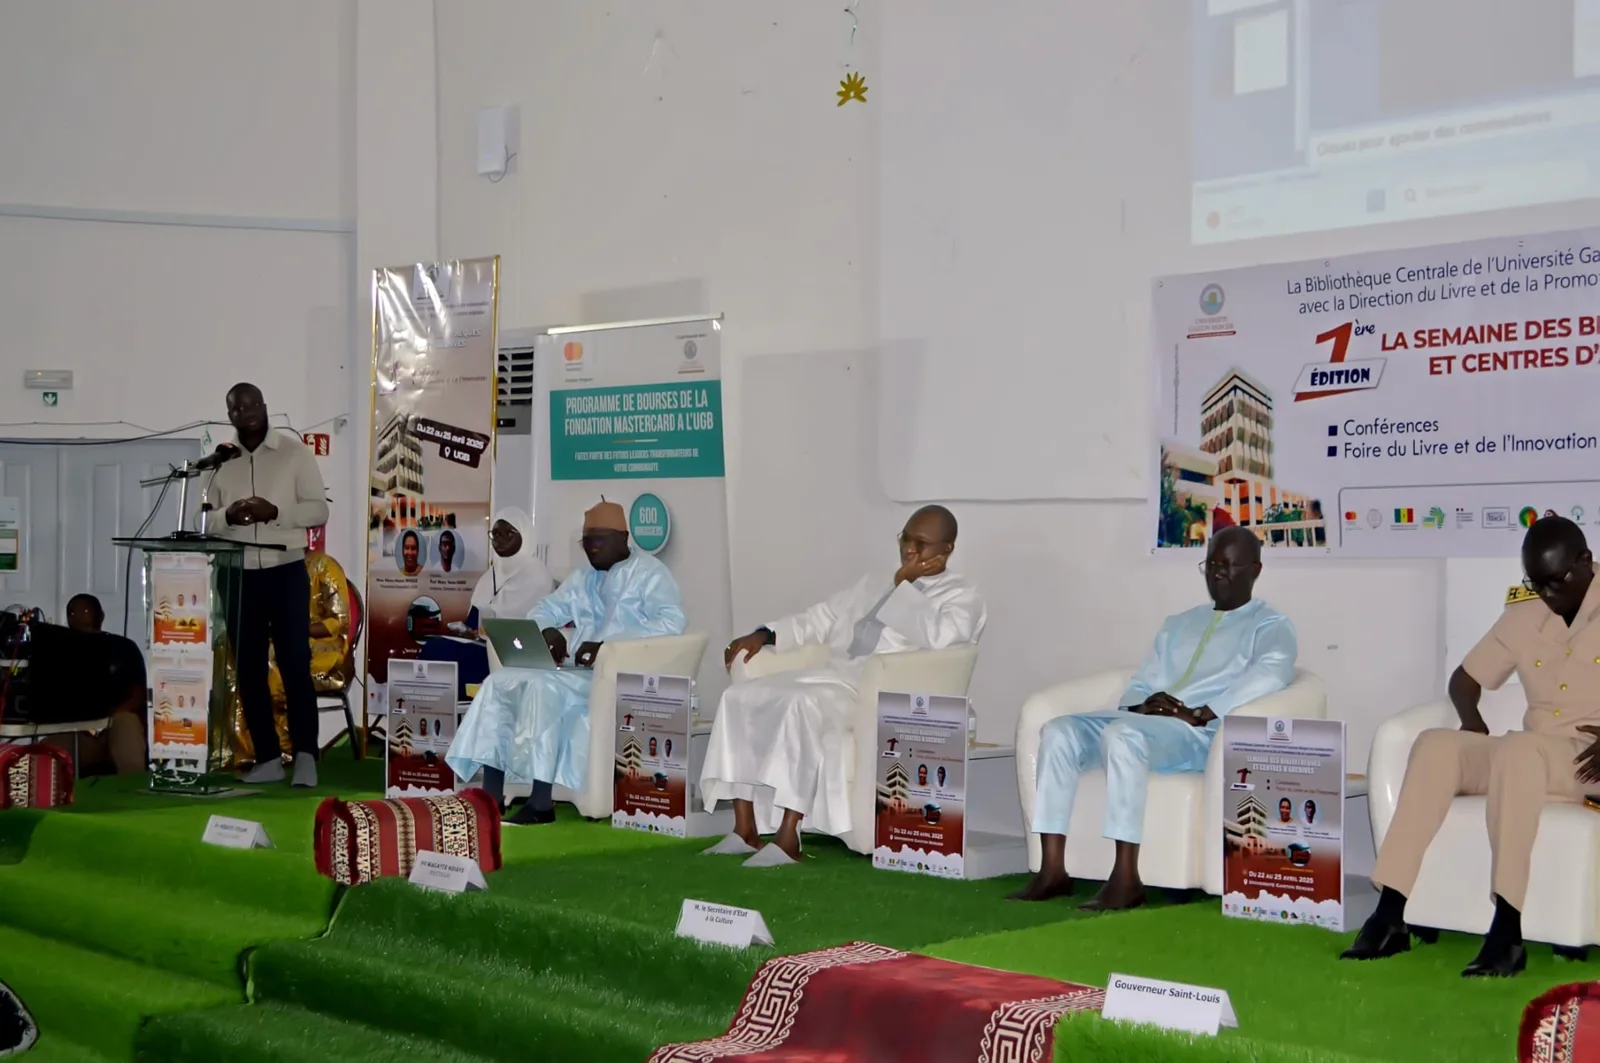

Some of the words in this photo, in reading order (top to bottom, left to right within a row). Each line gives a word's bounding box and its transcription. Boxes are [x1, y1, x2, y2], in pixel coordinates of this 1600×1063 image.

[1287, 279, 1302, 295] La
[1305, 271, 1392, 293] Bibliothèque
[1395, 261, 1459, 284] Centrale
[1462, 258, 1483, 276] de
[1299, 299, 1330, 315] avec
[1333, 295, 1345, 312] la
[1349, 290, 1413, 310] Direction
[1417, 285, 1436, 303] du
[1441, 283, 1476, 300] Livre
[1481, 281, 1496, 296] et
[1500, 277, 1520, 295] de
[1526, 275, 1538, 292] la
[1544, 273, 1600, 291] Promo
[1381, 331, 1409, 352] LA
[1413, 322, 1518, 349] SEMAINE
[1524, 317, 1572, 341] DES
[1429, 355, 1457, 376] ET
[1461, 346, 1569, 374] CENTRES
[1575, 343, 1600, 366] D'
[1310, 368, 1371, 387] ÉDITION
[566, 394, 621, 414] PROGRAMME
[623, 392, 635, 411] DE
[637, 390, 678, 411] BOURSES
[680, 389, 693, 408] DE
[695, 388, 709, 407] LA
[565, 416, 613, 436] FONDATION
[614, 413, 675, 434] MASTERCARD
[686, 411, 714, 430] L'UGB
[1343, 417, 1439, 437] Conférences
[453, 450, 470, 462] UGB
[1344, 440, 1381, 459] Foire
[1387, 440, 1407, 458] du
[1412, 439, 1449, 456] Livre
[1453, 438, 1470, 455] et
[1474, 435, 1498, 453] de
[1502, 432, 1598, 453] l'Innovation
[639, 507, 657, 524] 600
[1257, 871, 1265, 879] 22
[715, 916, 734, 925] Culture
[1114, 979, 1168, 996] Gouverneur
[1168, 988, 1221, 1004] Saint-Louis
